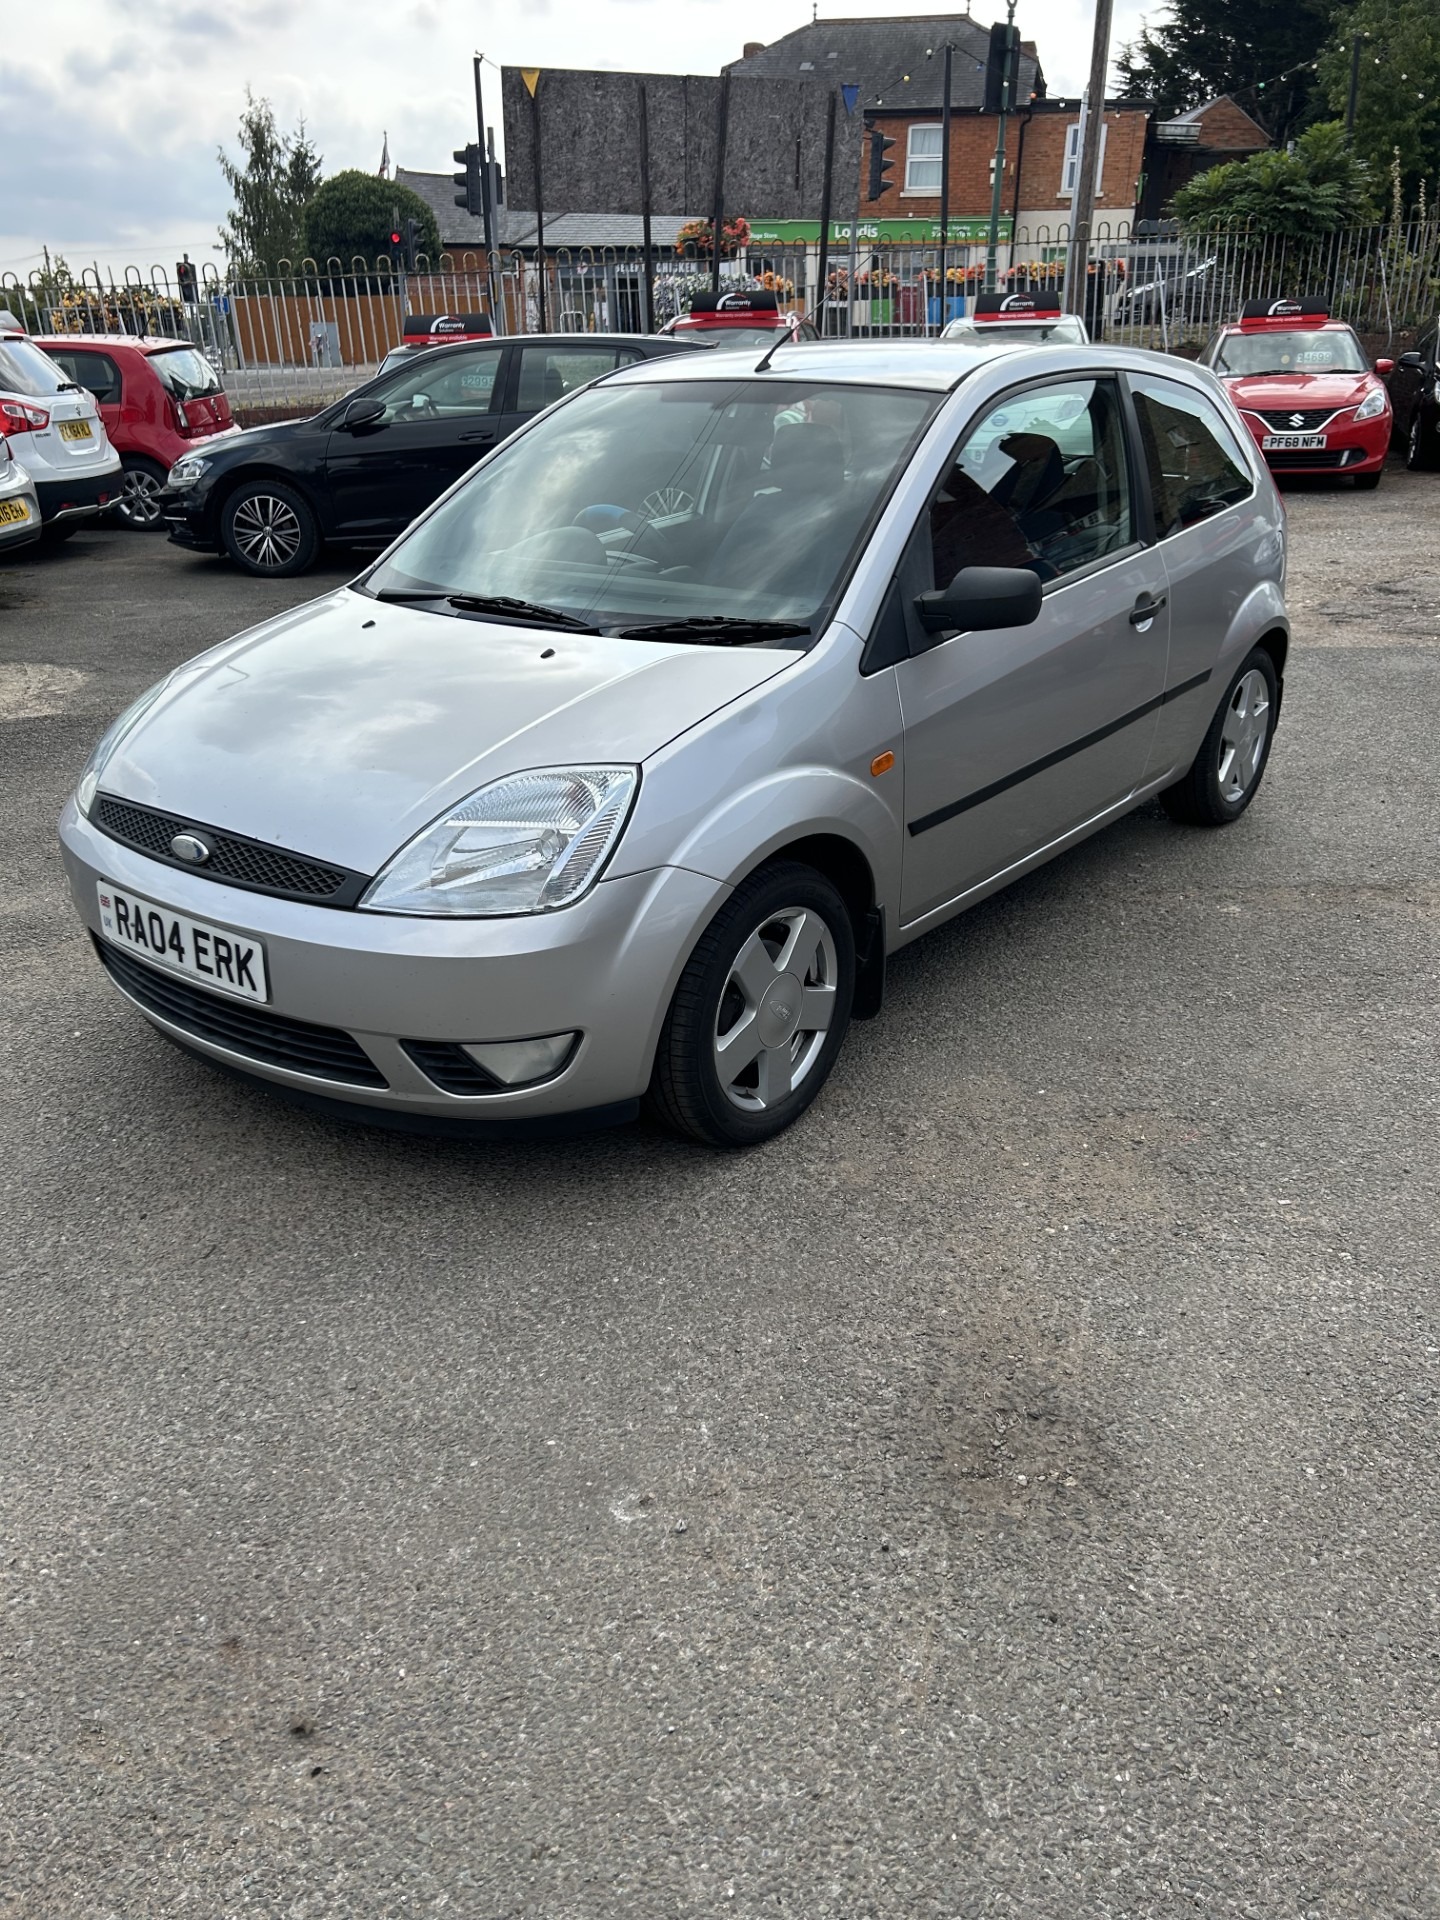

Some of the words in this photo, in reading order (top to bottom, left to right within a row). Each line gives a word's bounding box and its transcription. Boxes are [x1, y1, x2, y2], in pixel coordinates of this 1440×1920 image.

[1270, 437, 1299, 448] PF68
[103, 914, 112, 929] UK
[113, 895, 185, 963] RA04
[192, 927, 258, 992] ERK
